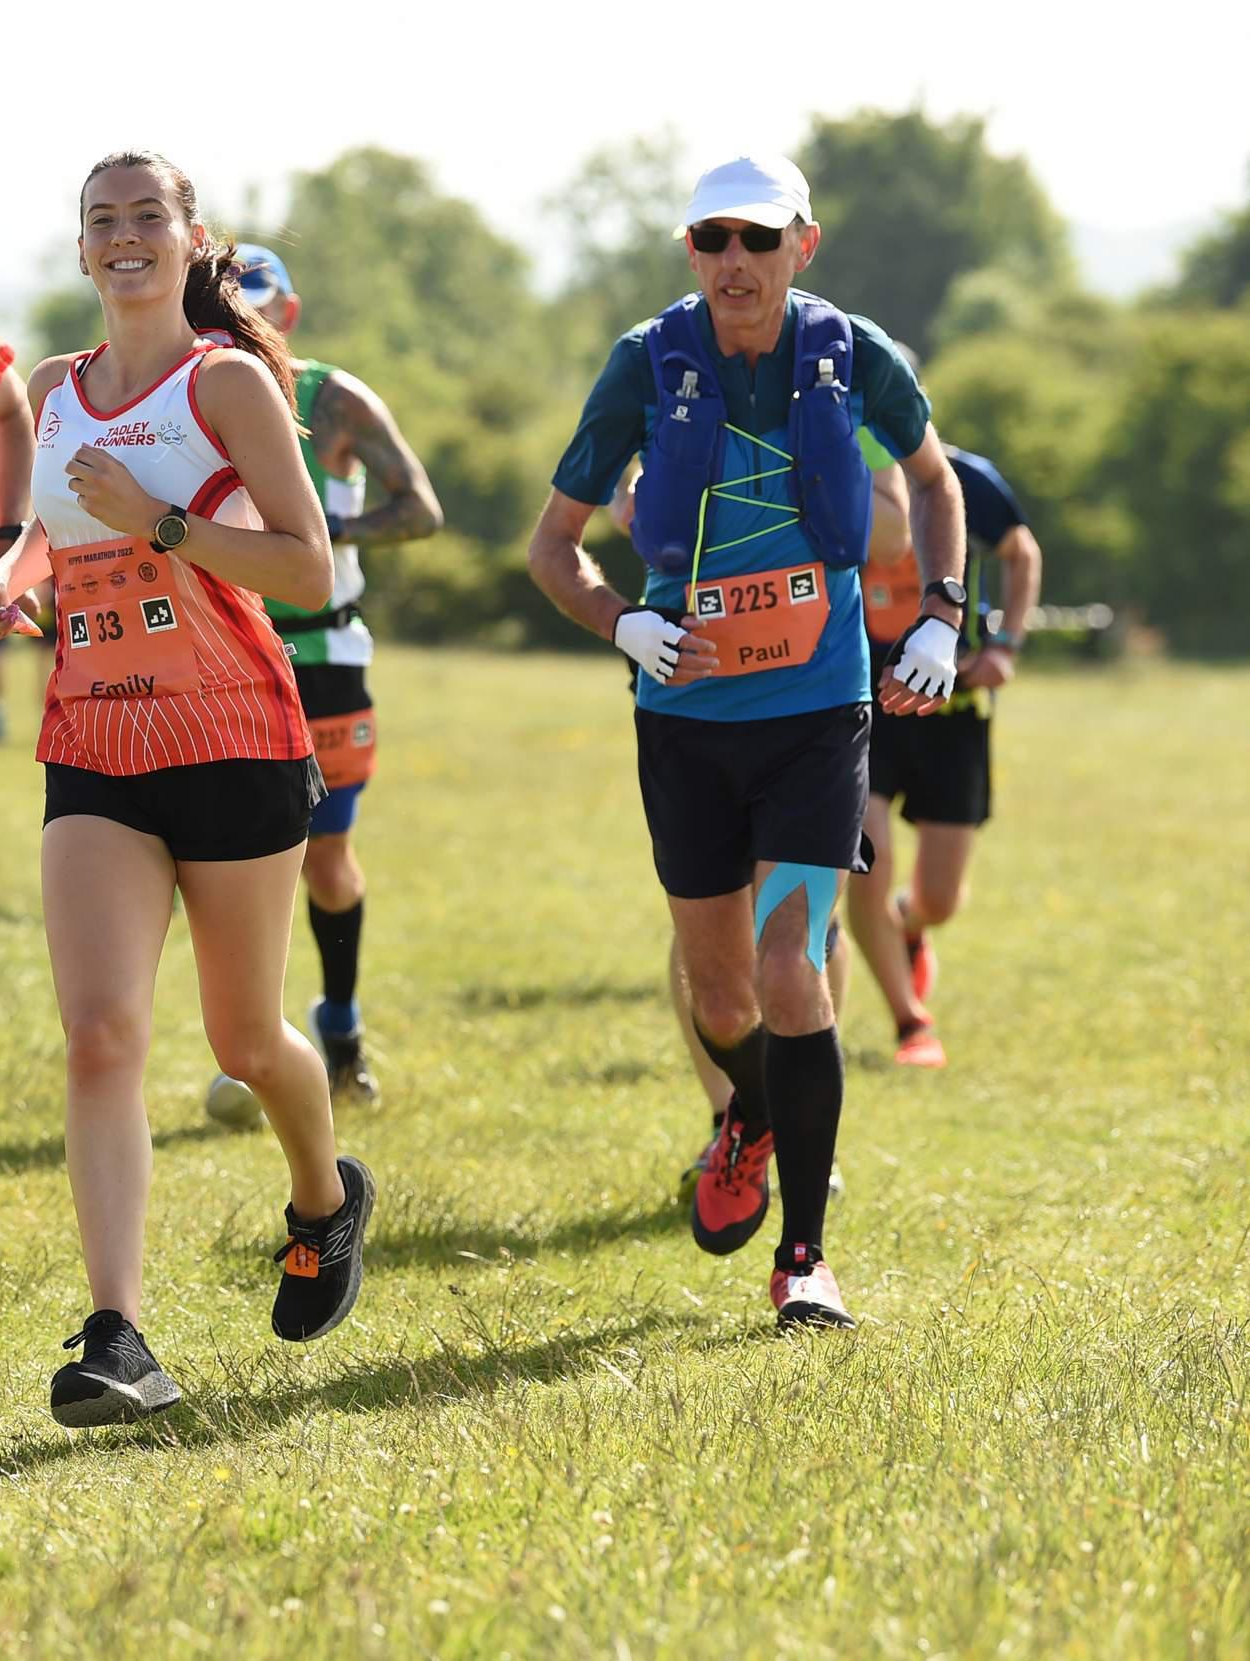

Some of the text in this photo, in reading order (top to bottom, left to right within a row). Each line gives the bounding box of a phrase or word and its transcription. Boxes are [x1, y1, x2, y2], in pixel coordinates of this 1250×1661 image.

[94, 434, 155, 447] RUNNERS
[107, 422, 150, 437] TADLEY
[730, 582, 778, 615] 225
[96, 611, 123, 643] 33
[739, 639, 790, 665] Paul
[91, 674, 154, 698] Emily
